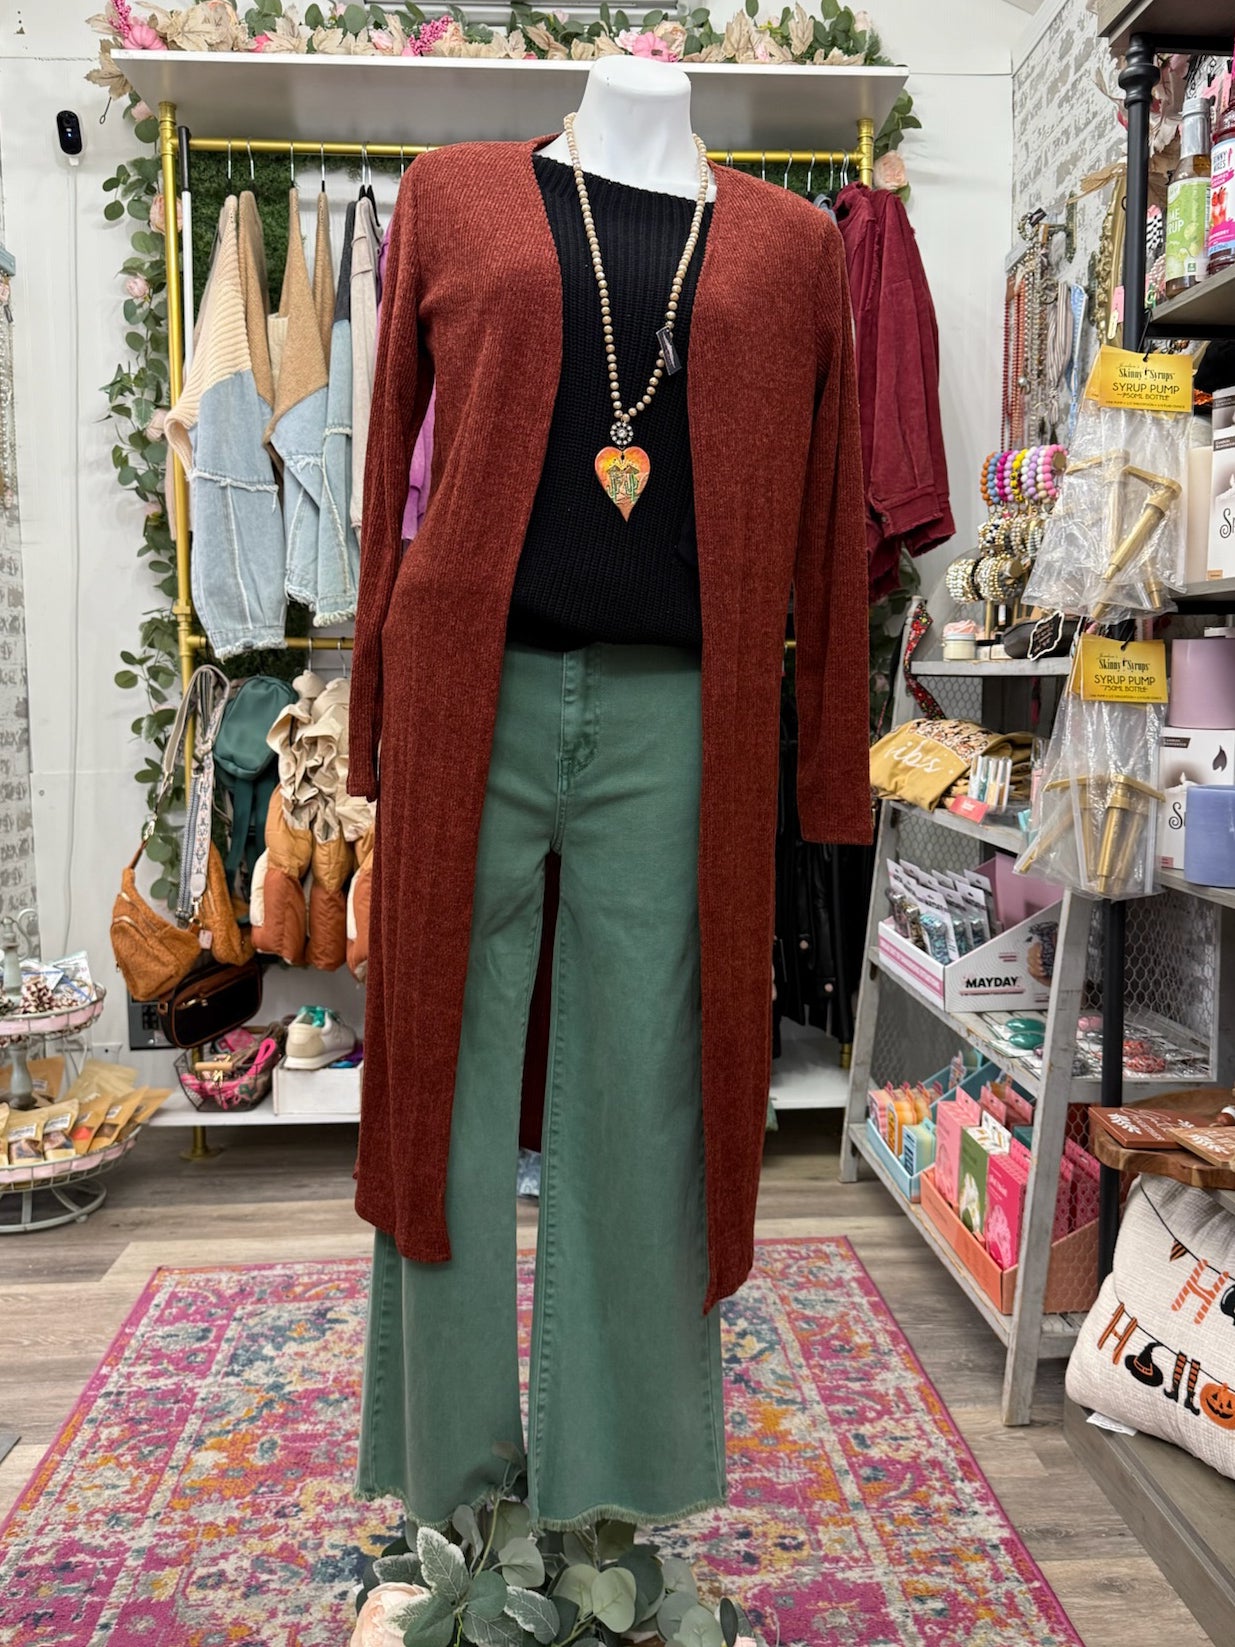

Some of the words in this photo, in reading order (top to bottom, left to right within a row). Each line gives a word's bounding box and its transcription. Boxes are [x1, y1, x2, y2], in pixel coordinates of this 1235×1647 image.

[1119, 368, 1142, 380] Skinny
[1149, 369, 1174, 382] Syrups
[1112, 382, 1147, 392] SYRUP
[1150, 384, 1180, 394] PUMP
[1145, 393, 1170, 401] BOTTLE
[1099, 658, 1121, 672] Skinny
[1127, 659, 1150, 673] Syrups
[1094, 674, 1126, 684] SYRUP
[1128, 676, 1156, 686] PUMP
[1125, 685, 1148, 693] BOTTLE
[965, 976, 1018, 988] MAYDAY
